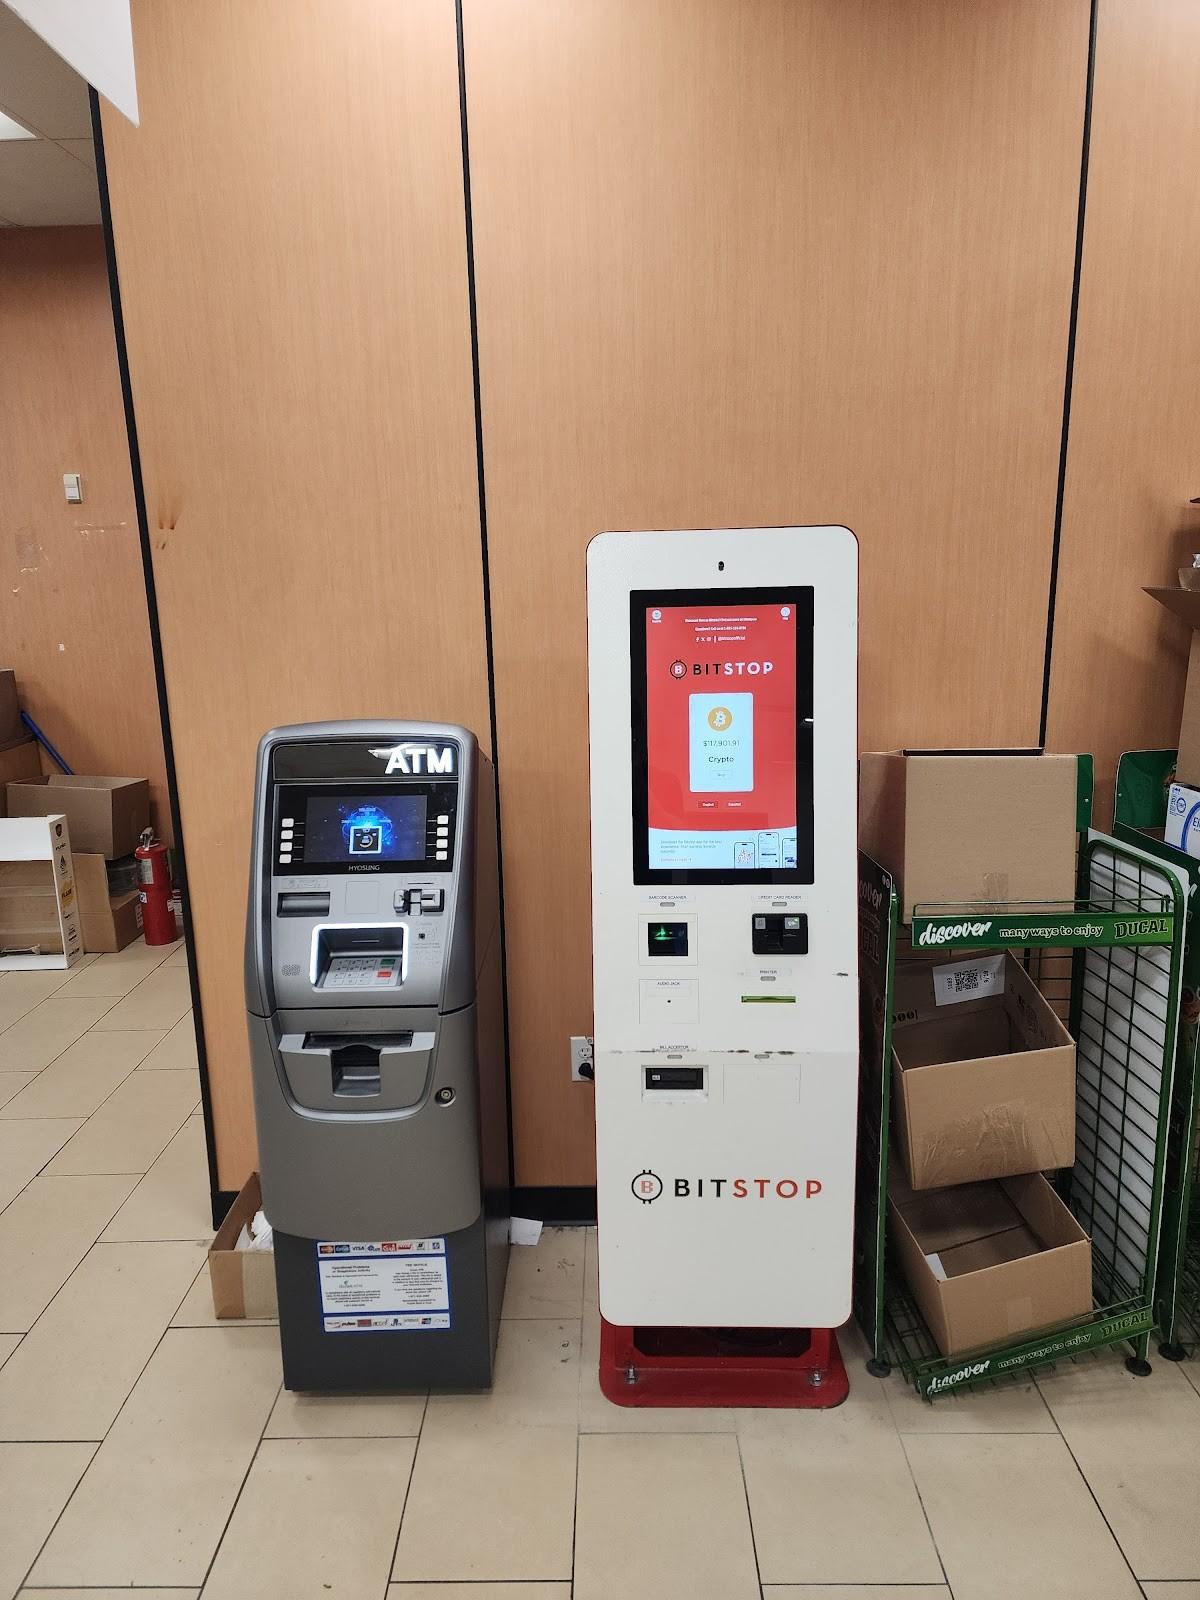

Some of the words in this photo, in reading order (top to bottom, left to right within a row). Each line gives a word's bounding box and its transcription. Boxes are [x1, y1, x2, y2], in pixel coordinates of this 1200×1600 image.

[693, 662, 773, 675] BITSTOP
[385, 748, 453, 774] ATM
[919, 921, 992, 946] discover
[999, 928, 1030, 940] many
[1030, 927, 1060, 939] ways
[1060, 925, 1074, 936] to
[1074, 923, 1104, 937] enjoy
[1114, 918, 1168, 939] DUCAL
[674, 1178, 822, 1199] BITSTOP
[927, 1360, 990, 1396] discover
[998, 1354, 1026, 1369] many
[1064, 1333, 1092, 1348] enjoy
[1100, 1311, 1149, 1338] DUCAL
